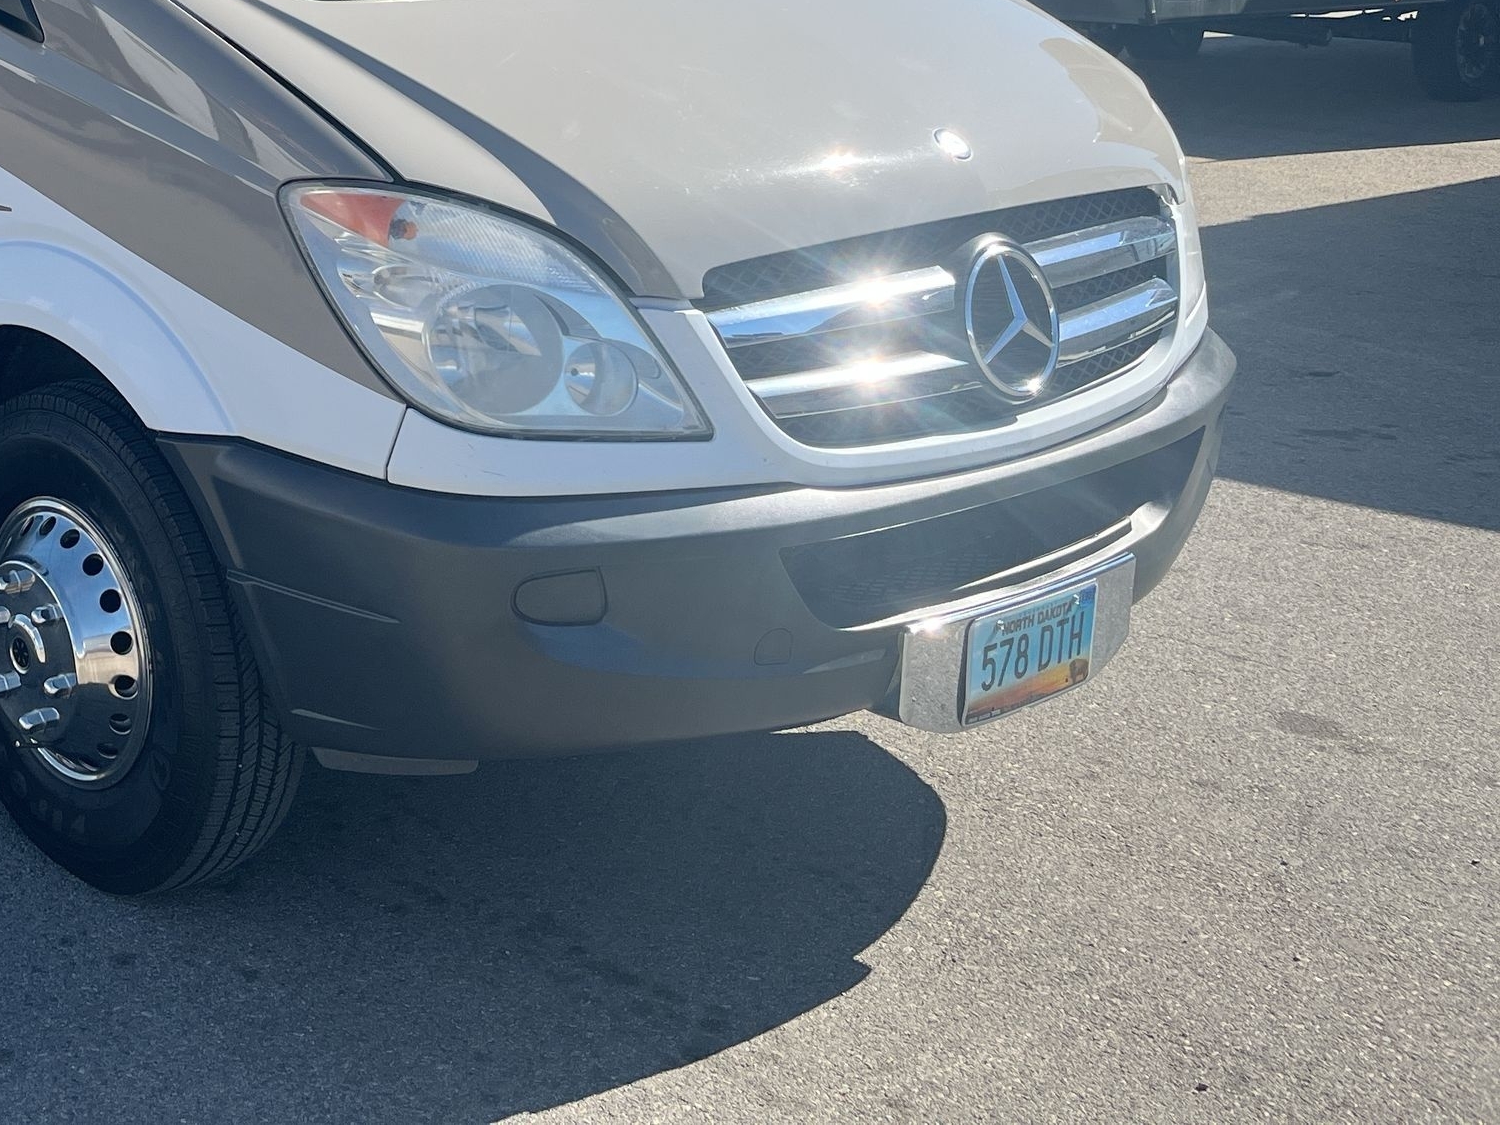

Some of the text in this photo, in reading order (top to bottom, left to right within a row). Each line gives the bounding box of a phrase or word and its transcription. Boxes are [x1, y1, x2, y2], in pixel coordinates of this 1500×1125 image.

[1002, 601, 1072, 635] NORTH DAKOTA
[981, 611, 1084, 691] 578 DTH
